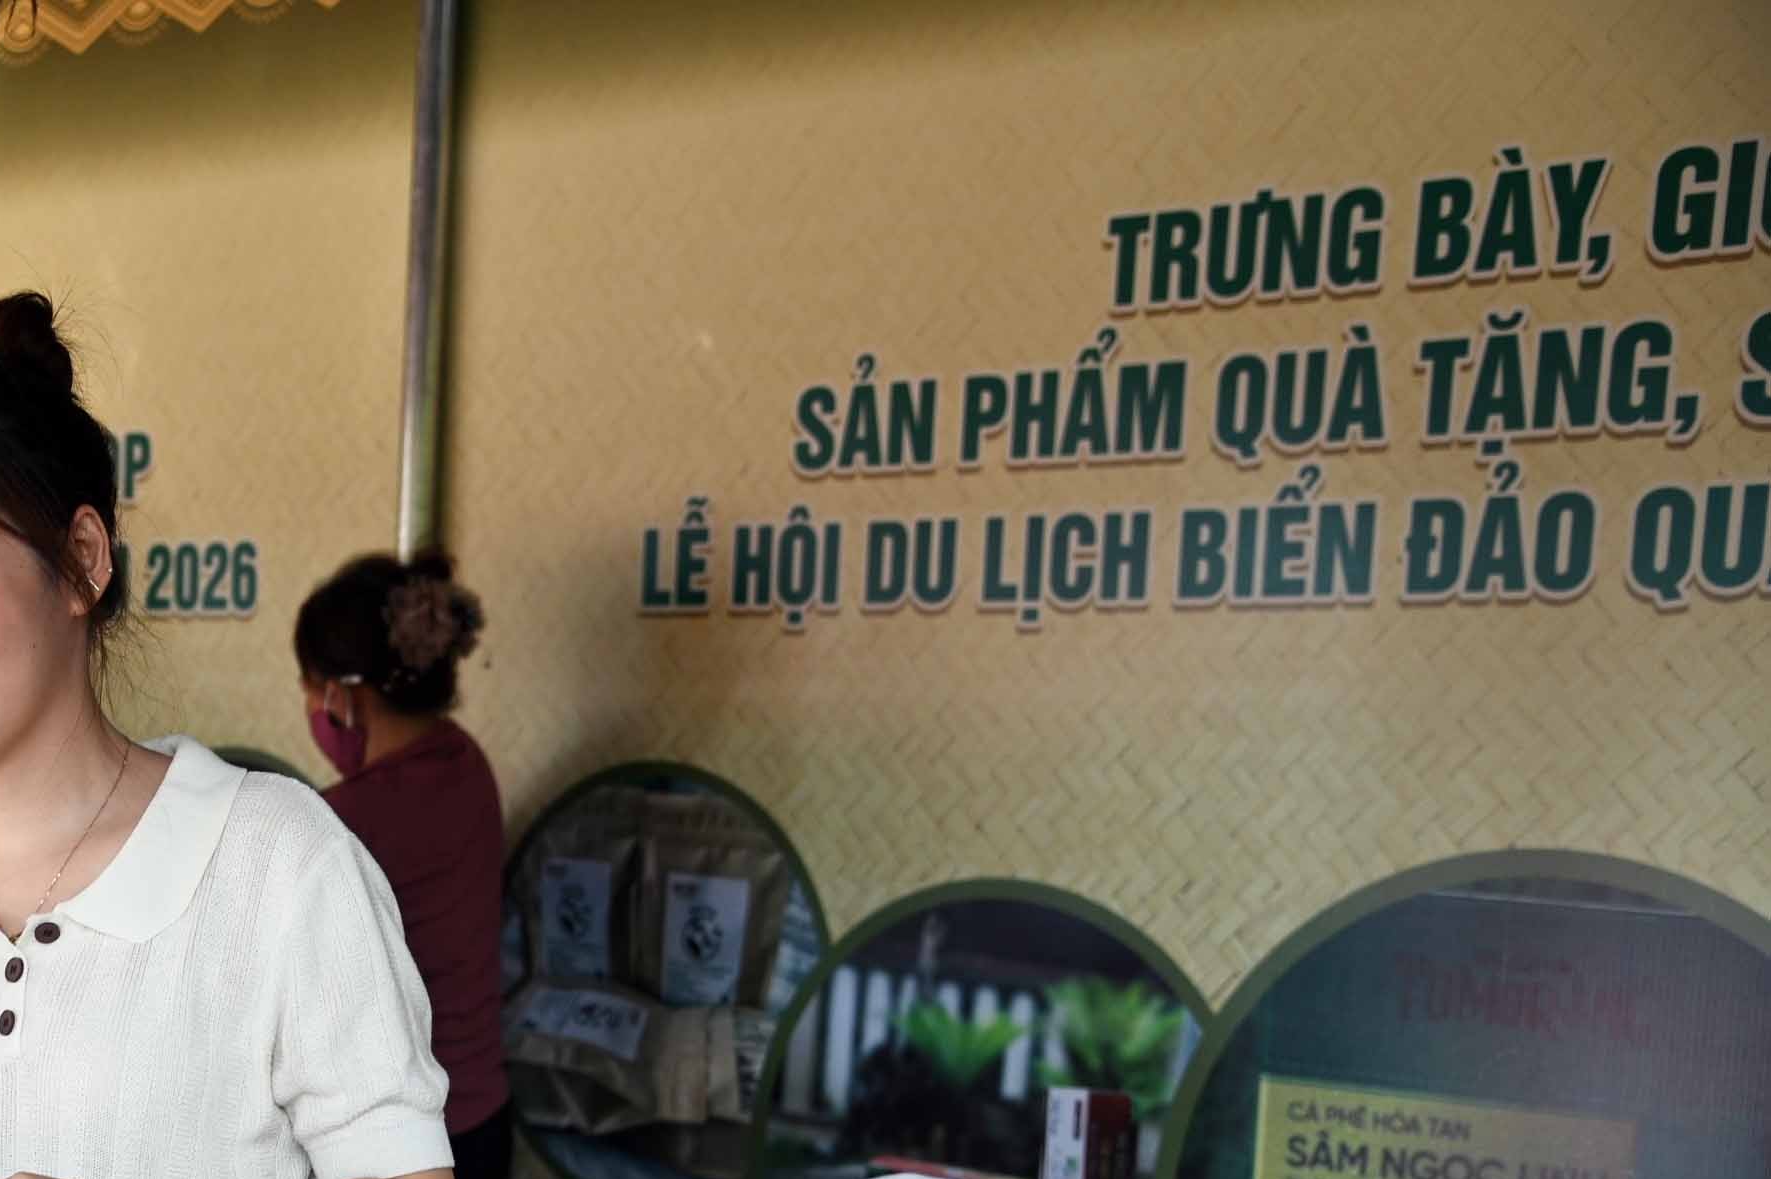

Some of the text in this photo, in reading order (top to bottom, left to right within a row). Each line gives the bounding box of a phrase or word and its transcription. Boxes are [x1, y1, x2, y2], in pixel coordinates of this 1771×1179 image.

[1107, 139, 1771, 308] TRƯNG BÀY, GI
[794, 353, 938, 473] SẢN
[960, 327, 1189, 464] PHẨM
[1214, 324, 1387, 461] QUÀ
[1419, 310, 1701, 456] TẶNG,
[146, 542, 258, 611] 2026
[641, 496, 712, 608] LỄ
[732, 504, 841, 626] HỘI
[865, 517, 958, 607] DU
[980, 510, 1151, 625] LỊCH
[1178, 464, 1377, 600] BIỂN
[1404, 460, 1595, 597] ĐẢO
[1286, 1129, 1369, 1176] SÂM
[1287, 1099, 1320, 1123] CÀ
[1428, 1116, 1472, 1141] TAN
